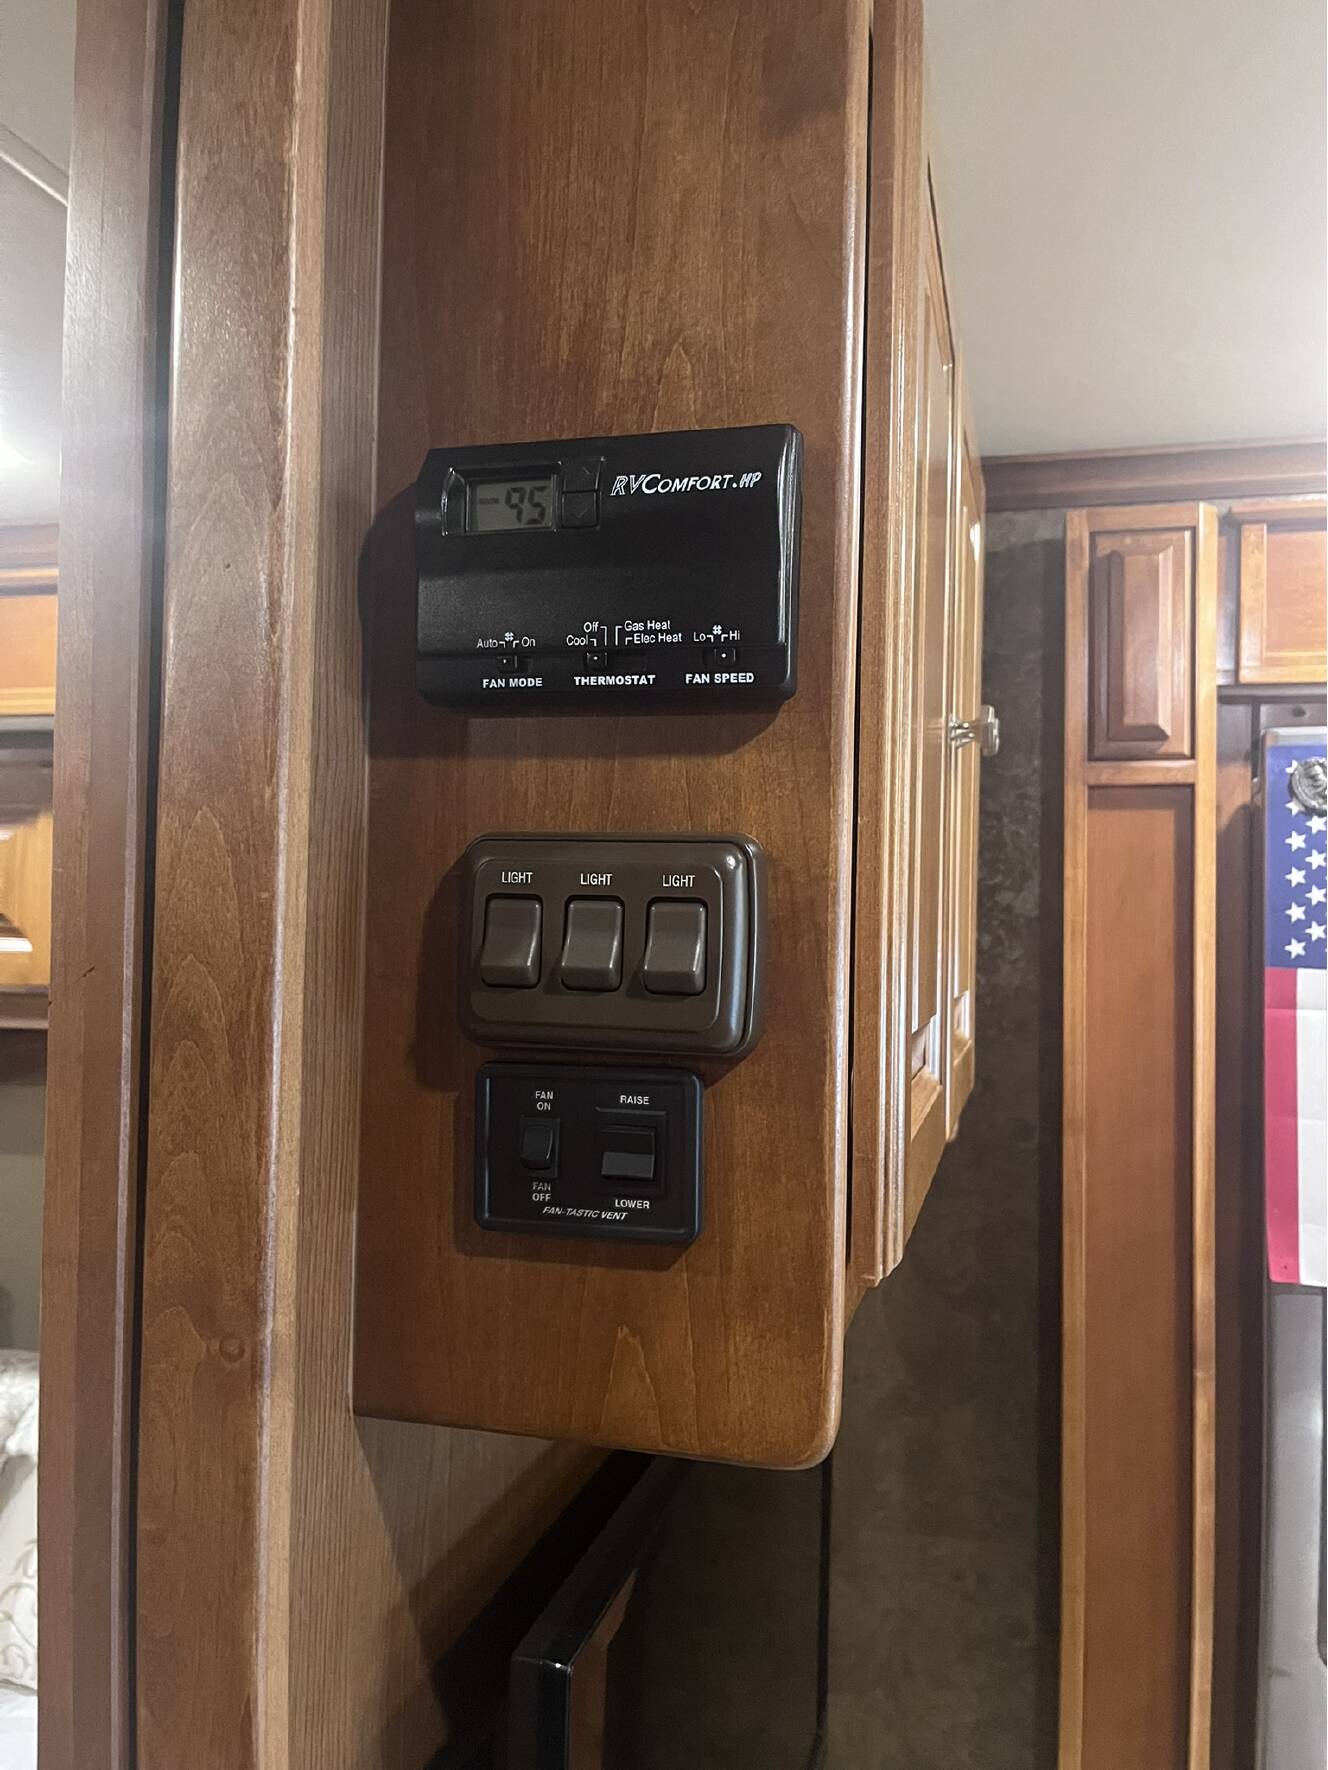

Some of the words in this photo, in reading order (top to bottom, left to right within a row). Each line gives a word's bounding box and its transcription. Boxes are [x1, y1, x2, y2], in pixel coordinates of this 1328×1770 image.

[583, 621, 599, 633] Off
[624, 620, 645, 631] Gas
[647, 619, 671, 631] Heat
[566, 634, 589, 646] Cool
[633, 633, 656, 644] Elec
[658, 632, 682, 643] Heat
[693, 632, 707, 642] Lo
[729, 630, 741, 641] Hi
[476, 638, 499, 648] Auto
[521, 636, 536, 648] On
[482, 679, 506, 689] FAN
[509, 677, 543, 688] MODE
[573, 674, 656, 686] THERMOSTAT
[685, 673, 710, 684] FAN
[714, 672, 755, 684] SPEED
[501, 871, 533, 884] LIGHT
[580, 873, 613, 886] LIGHT
[662, 875, 696, 888] LIGHT
[535, 1090, 554, 1100] FAN
[620, 1095, 650, 1105] RAISE
[536, 1101, 551, 1111] ON
[532, 1181, 552, 1191] FAN
[532, 1192, 552, 1202] OFF
[614, 1199, 650, 1209] LOWER
[542, 1206, 600, 1218] FAN-TASTIC
[601, 1211, 628, 1220] VENT
